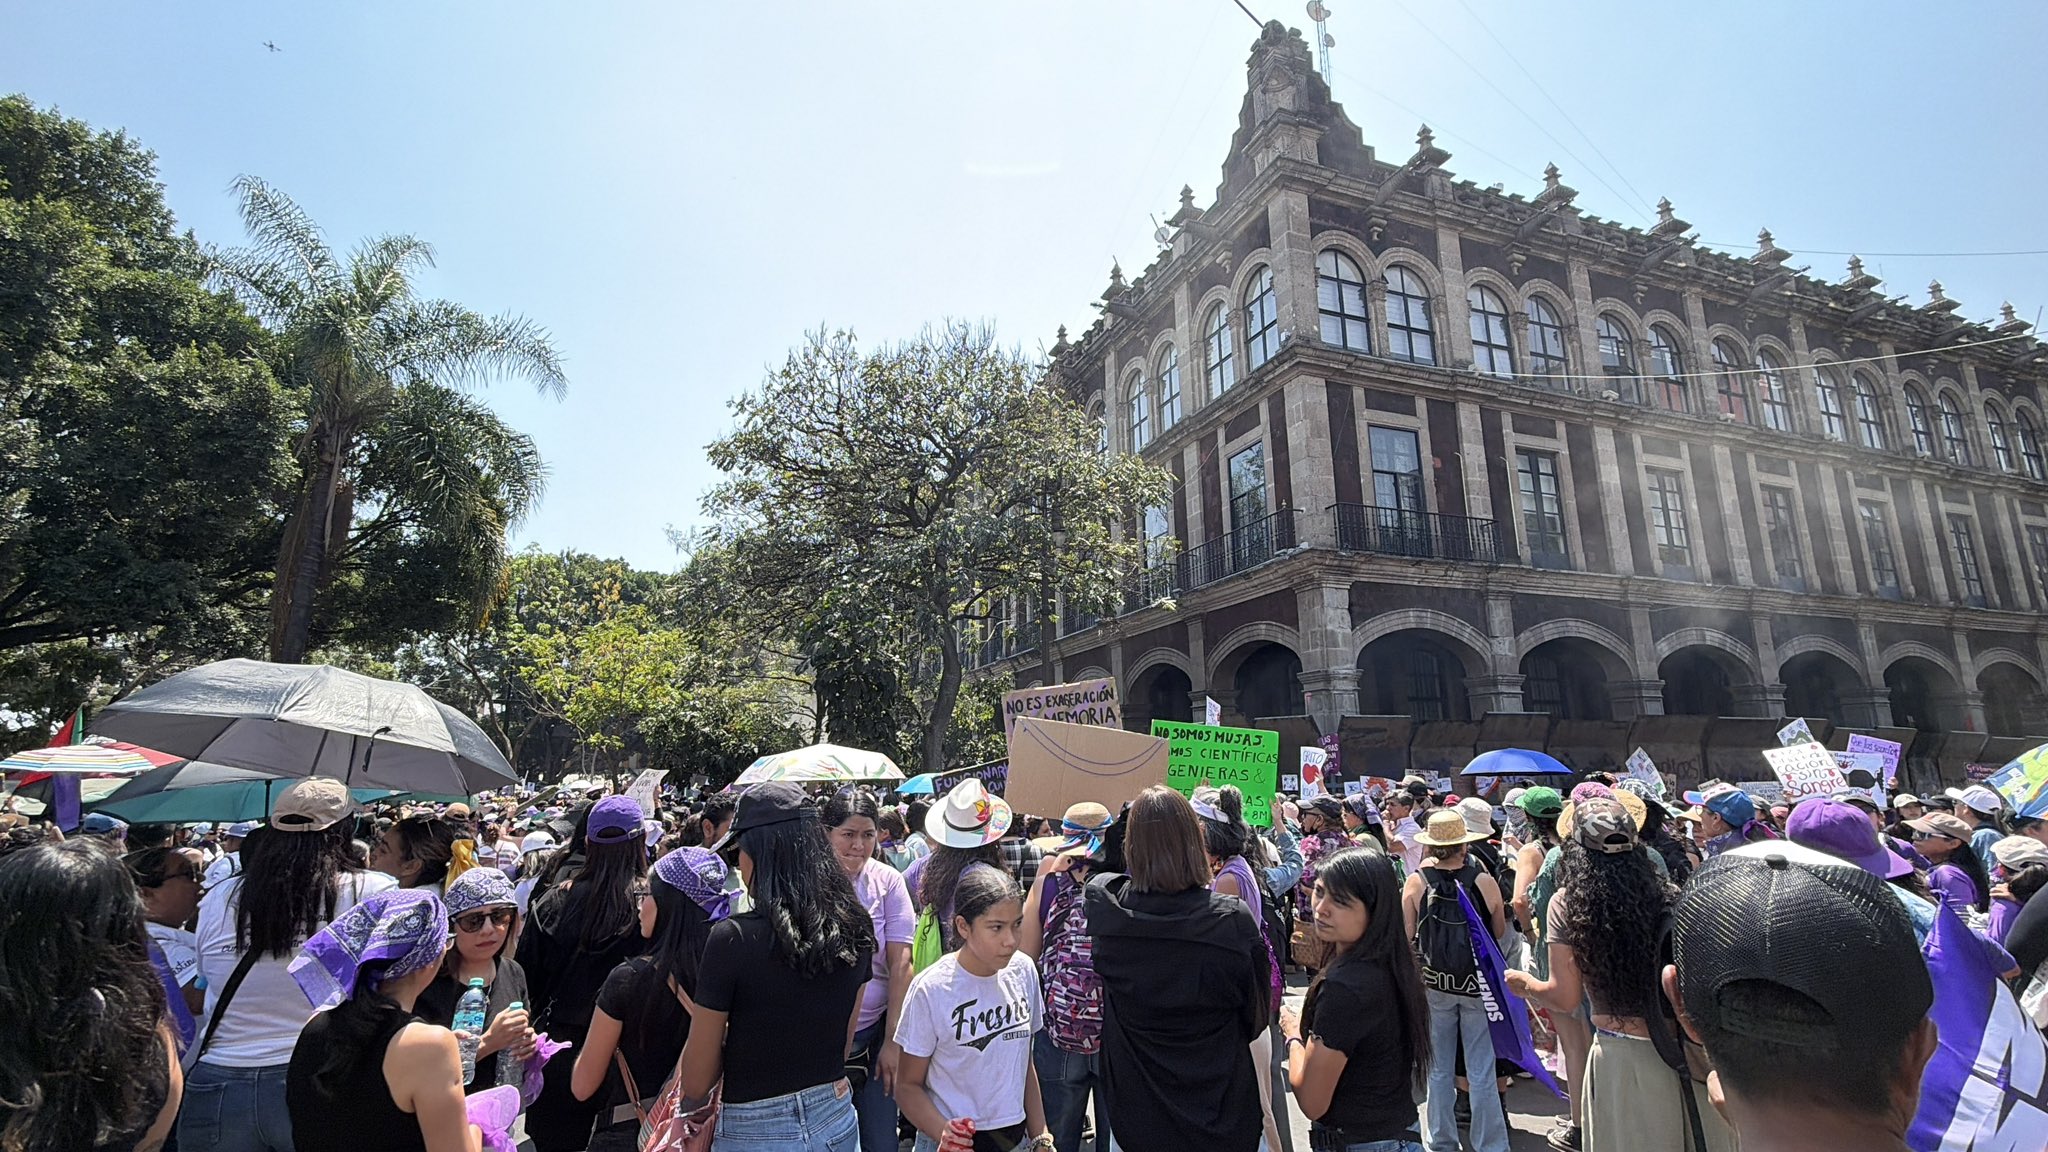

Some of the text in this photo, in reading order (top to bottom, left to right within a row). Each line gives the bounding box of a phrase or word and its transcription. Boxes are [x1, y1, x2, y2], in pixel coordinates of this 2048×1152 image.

[1006, 684, 1114, 714] NO ES EXAGERACIÓN
[1154, 726, 1170, 739] NO
[1172, 728, 1212, 742] SOMOS
[1200, 747, 1278, 764] CIENTÍFICAS
[1254, 769, 1266, 784] &
[1787, 777, 1847, 798] Sangre
[1422, 967, 1482, 995] FILA
[951, 998, 1031, 1041] Fresno
